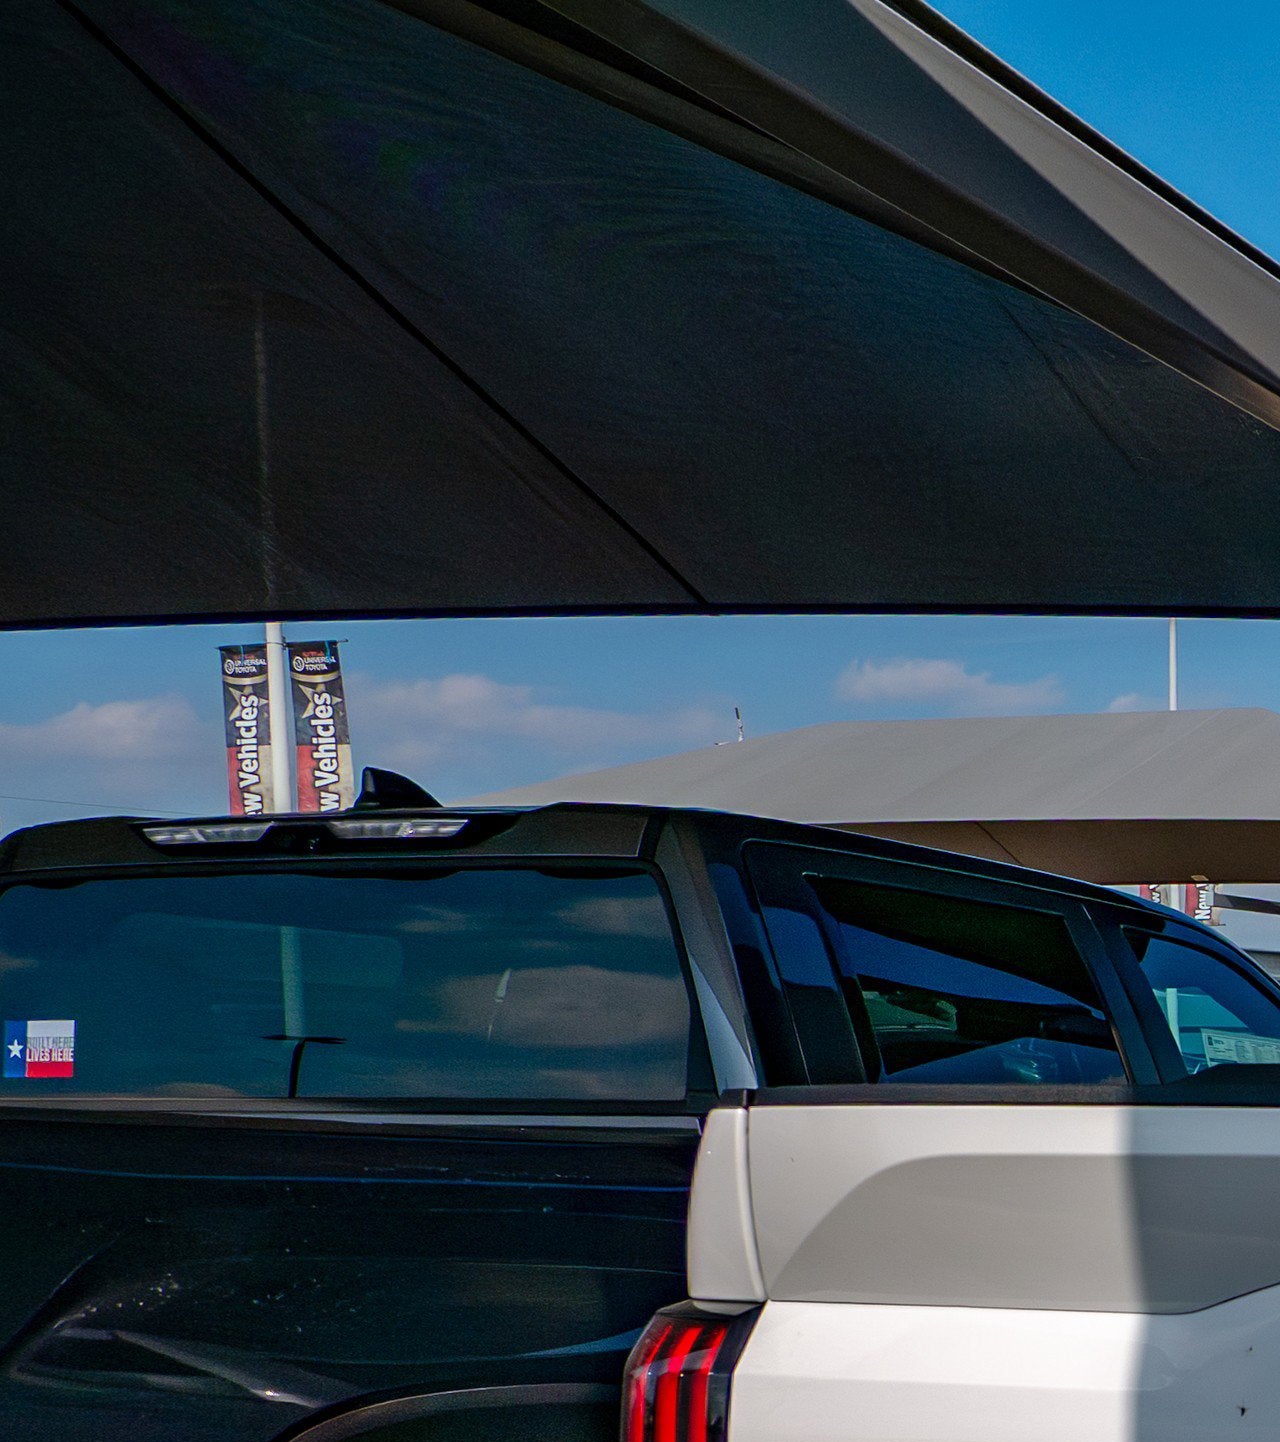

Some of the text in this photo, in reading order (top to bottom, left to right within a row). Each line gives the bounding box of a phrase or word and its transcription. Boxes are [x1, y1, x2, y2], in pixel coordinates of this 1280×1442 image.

[235, 694, 260, 789] Vehicles
[310, 692, 339, 788] Vehicles
[26, 1048, 74, 1062] LIVES HERE
